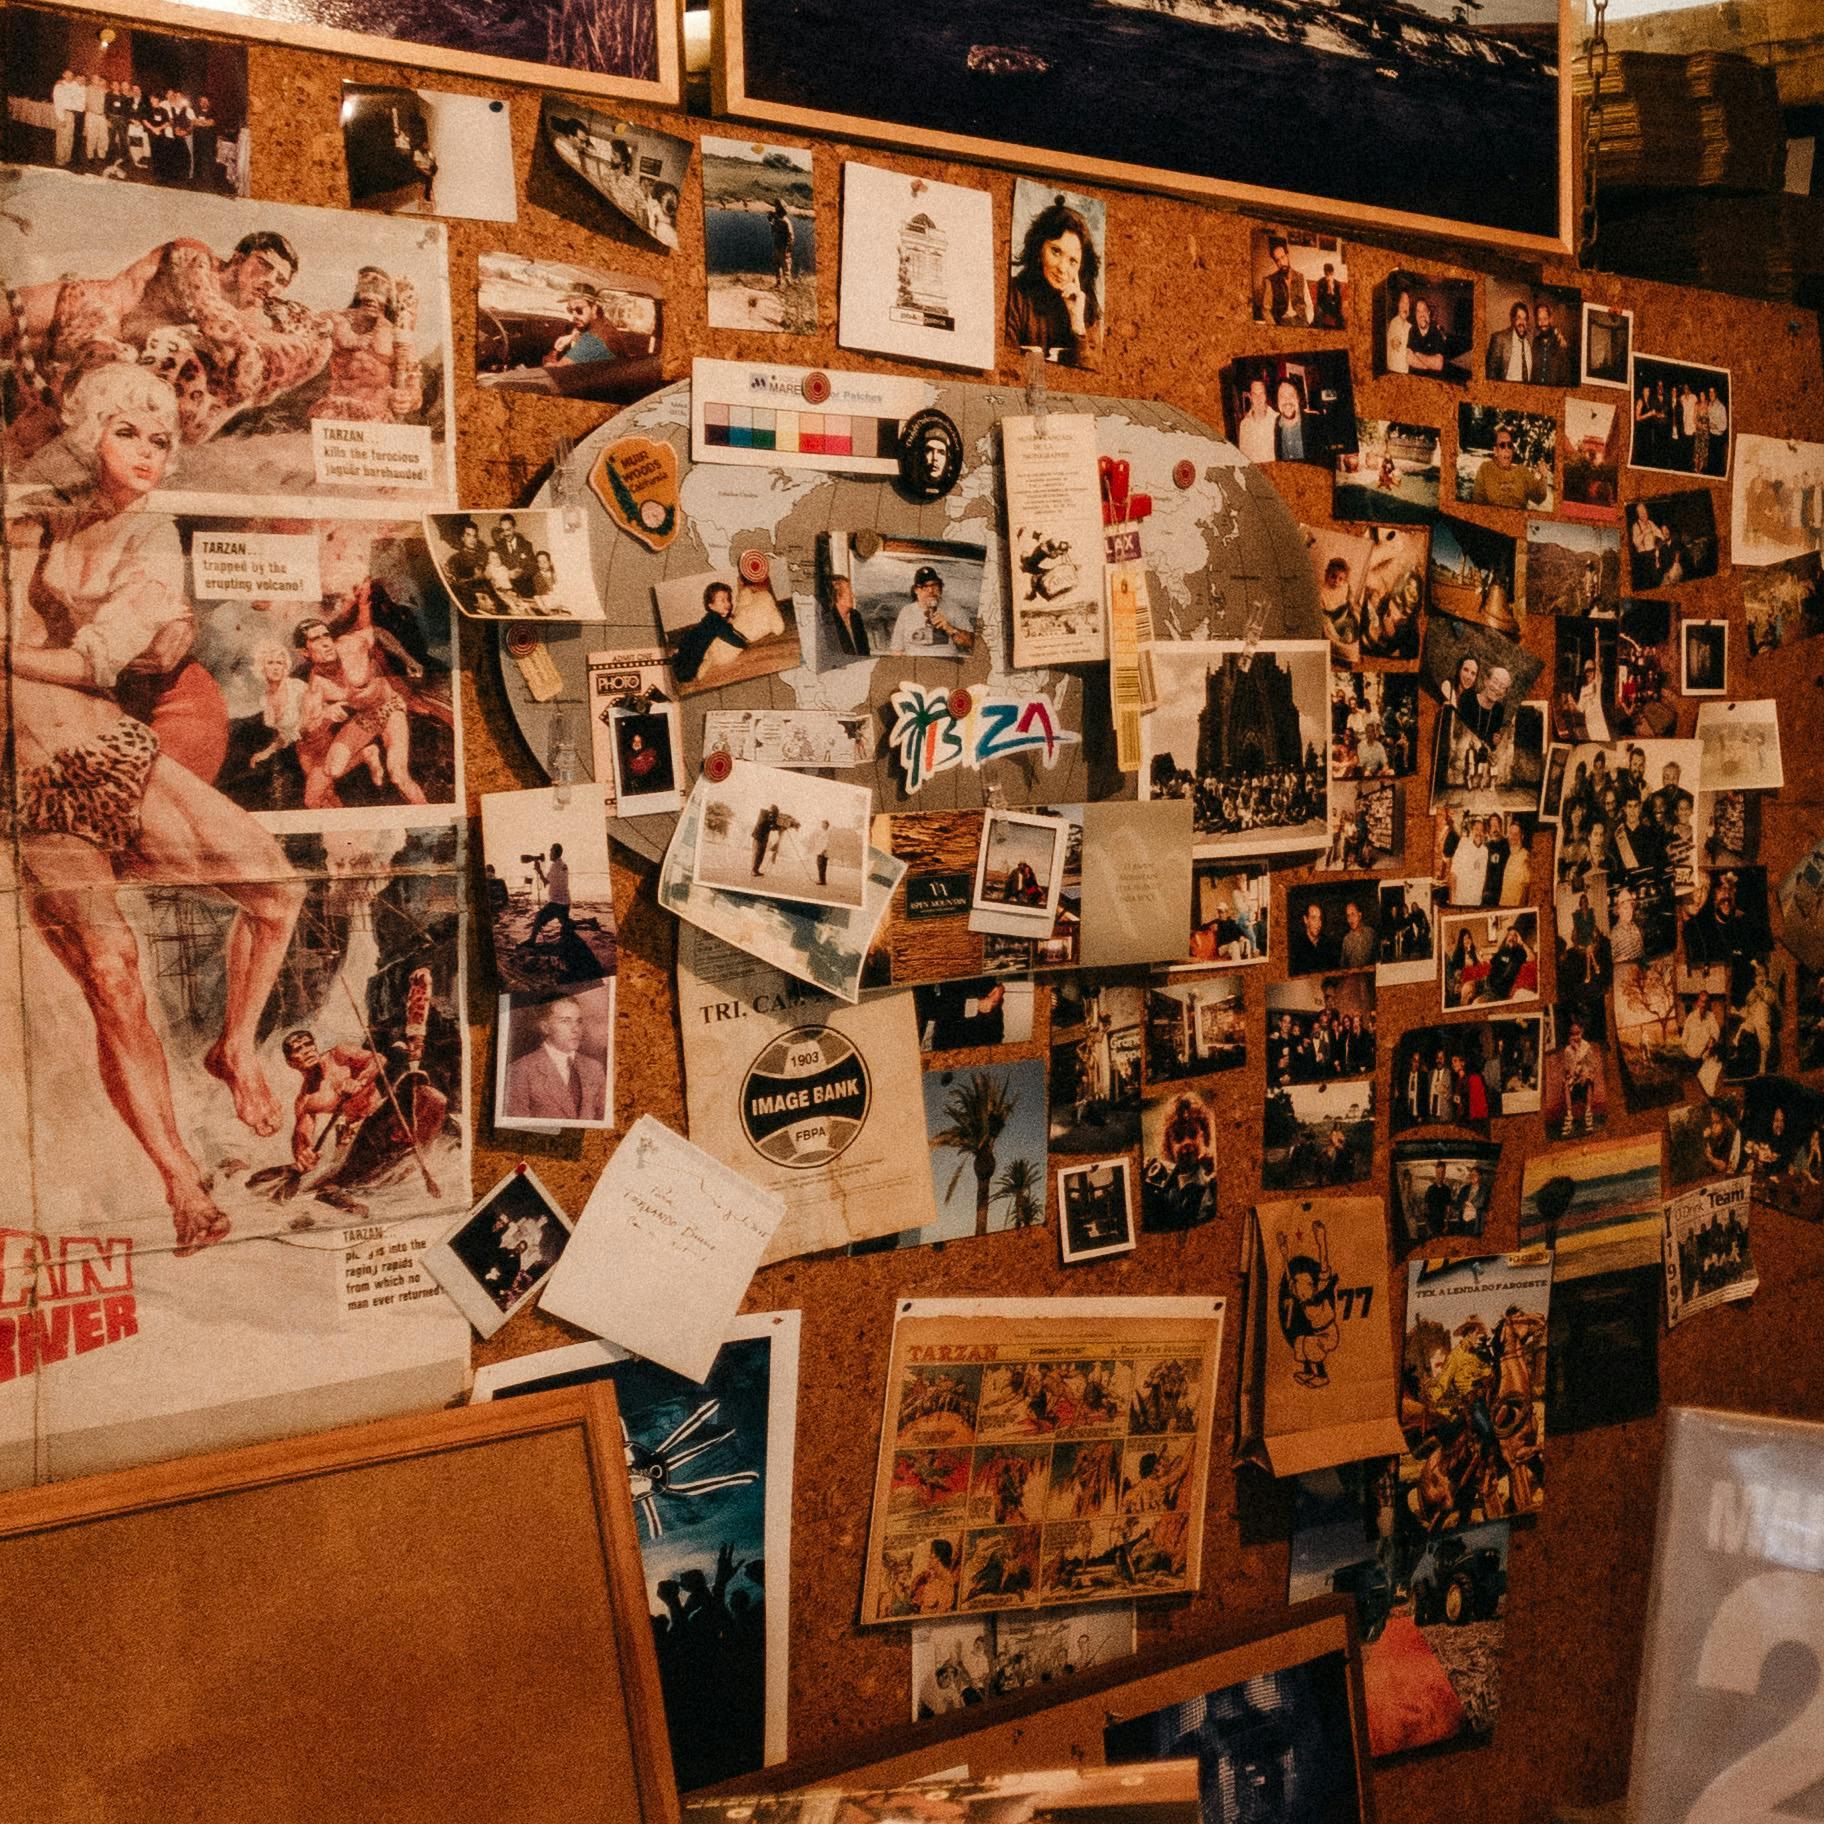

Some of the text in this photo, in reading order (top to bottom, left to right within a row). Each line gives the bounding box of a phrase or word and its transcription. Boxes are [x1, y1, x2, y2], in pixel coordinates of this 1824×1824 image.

[350, 447, 367, 459] the
[268, 562, 288, 574] the
[205, 578, 253, 593] erupting
[599, 675, 640, 690] PHOTO
[700, 1000, 748, 1025] TRI.
[791, 1050, 820, 1069] 1903
[752, 1078, 860, 1116] IMAGE BANK
[795, 1126, 827, 1143] FBPA
[1707, 1188, 1745, 1209] Team
[388, 1242, 408, 1254] into
[410, 1238, 427, 1250] the
[381, 1258, 413, 1273] rapids
[346, 1274, 421, 1295] from which no
[1447, 1285, 1480, 1296] LENDA
[1482, 1283, 1495, 1293] DO
[1495, 1279, 1548, 1291] FAROESTE
[348, 1299, 369, 1311] man
[373, 1294, 395, 1307] ever
[1337, 1285, 1374, 1322] 77
[909, 1343, 998, 1363] TARZAN
